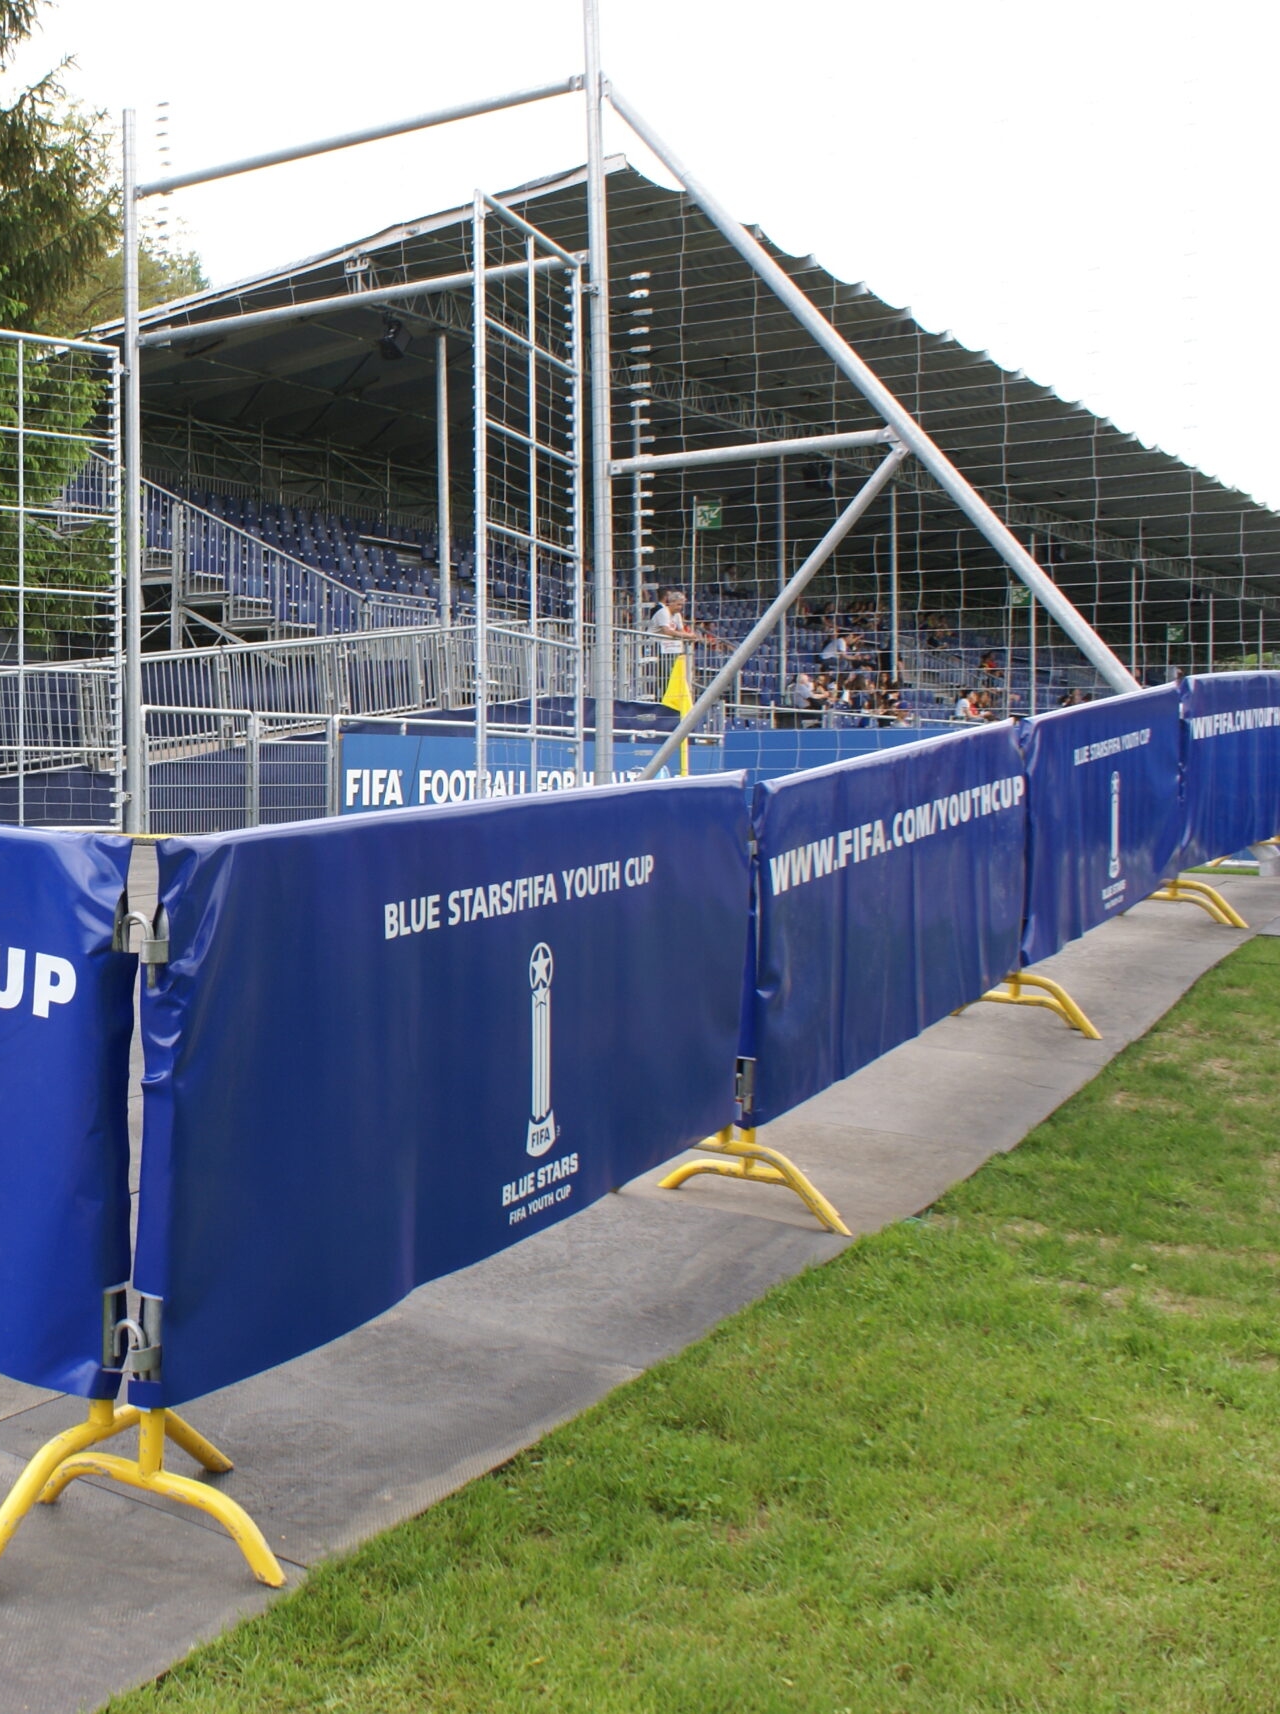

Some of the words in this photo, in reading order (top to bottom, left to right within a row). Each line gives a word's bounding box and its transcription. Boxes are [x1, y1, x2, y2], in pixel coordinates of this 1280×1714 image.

[346, 769, 403, 806] FIFA
[769, 775, 1026, 896] WWW.FIFA.COM/YOUTHCUP
[384, 894, 440, 940] BLUE
[448, 873, 558, 926] STARS/FIFA
[562, 860, 620, 900] YOUTH
[624, 854, 654, 888] CUP
[531, 1127, 551, 1148] FIFA
[502, 1171, 535, 1207] BLUE
[537, 1152, 578, 1189] STARS
[509, 1206, 526, 1225] FIFA
[528, 1192, 554, 1215] YOUTH
[555, 1184, 572, 1202] CUP
